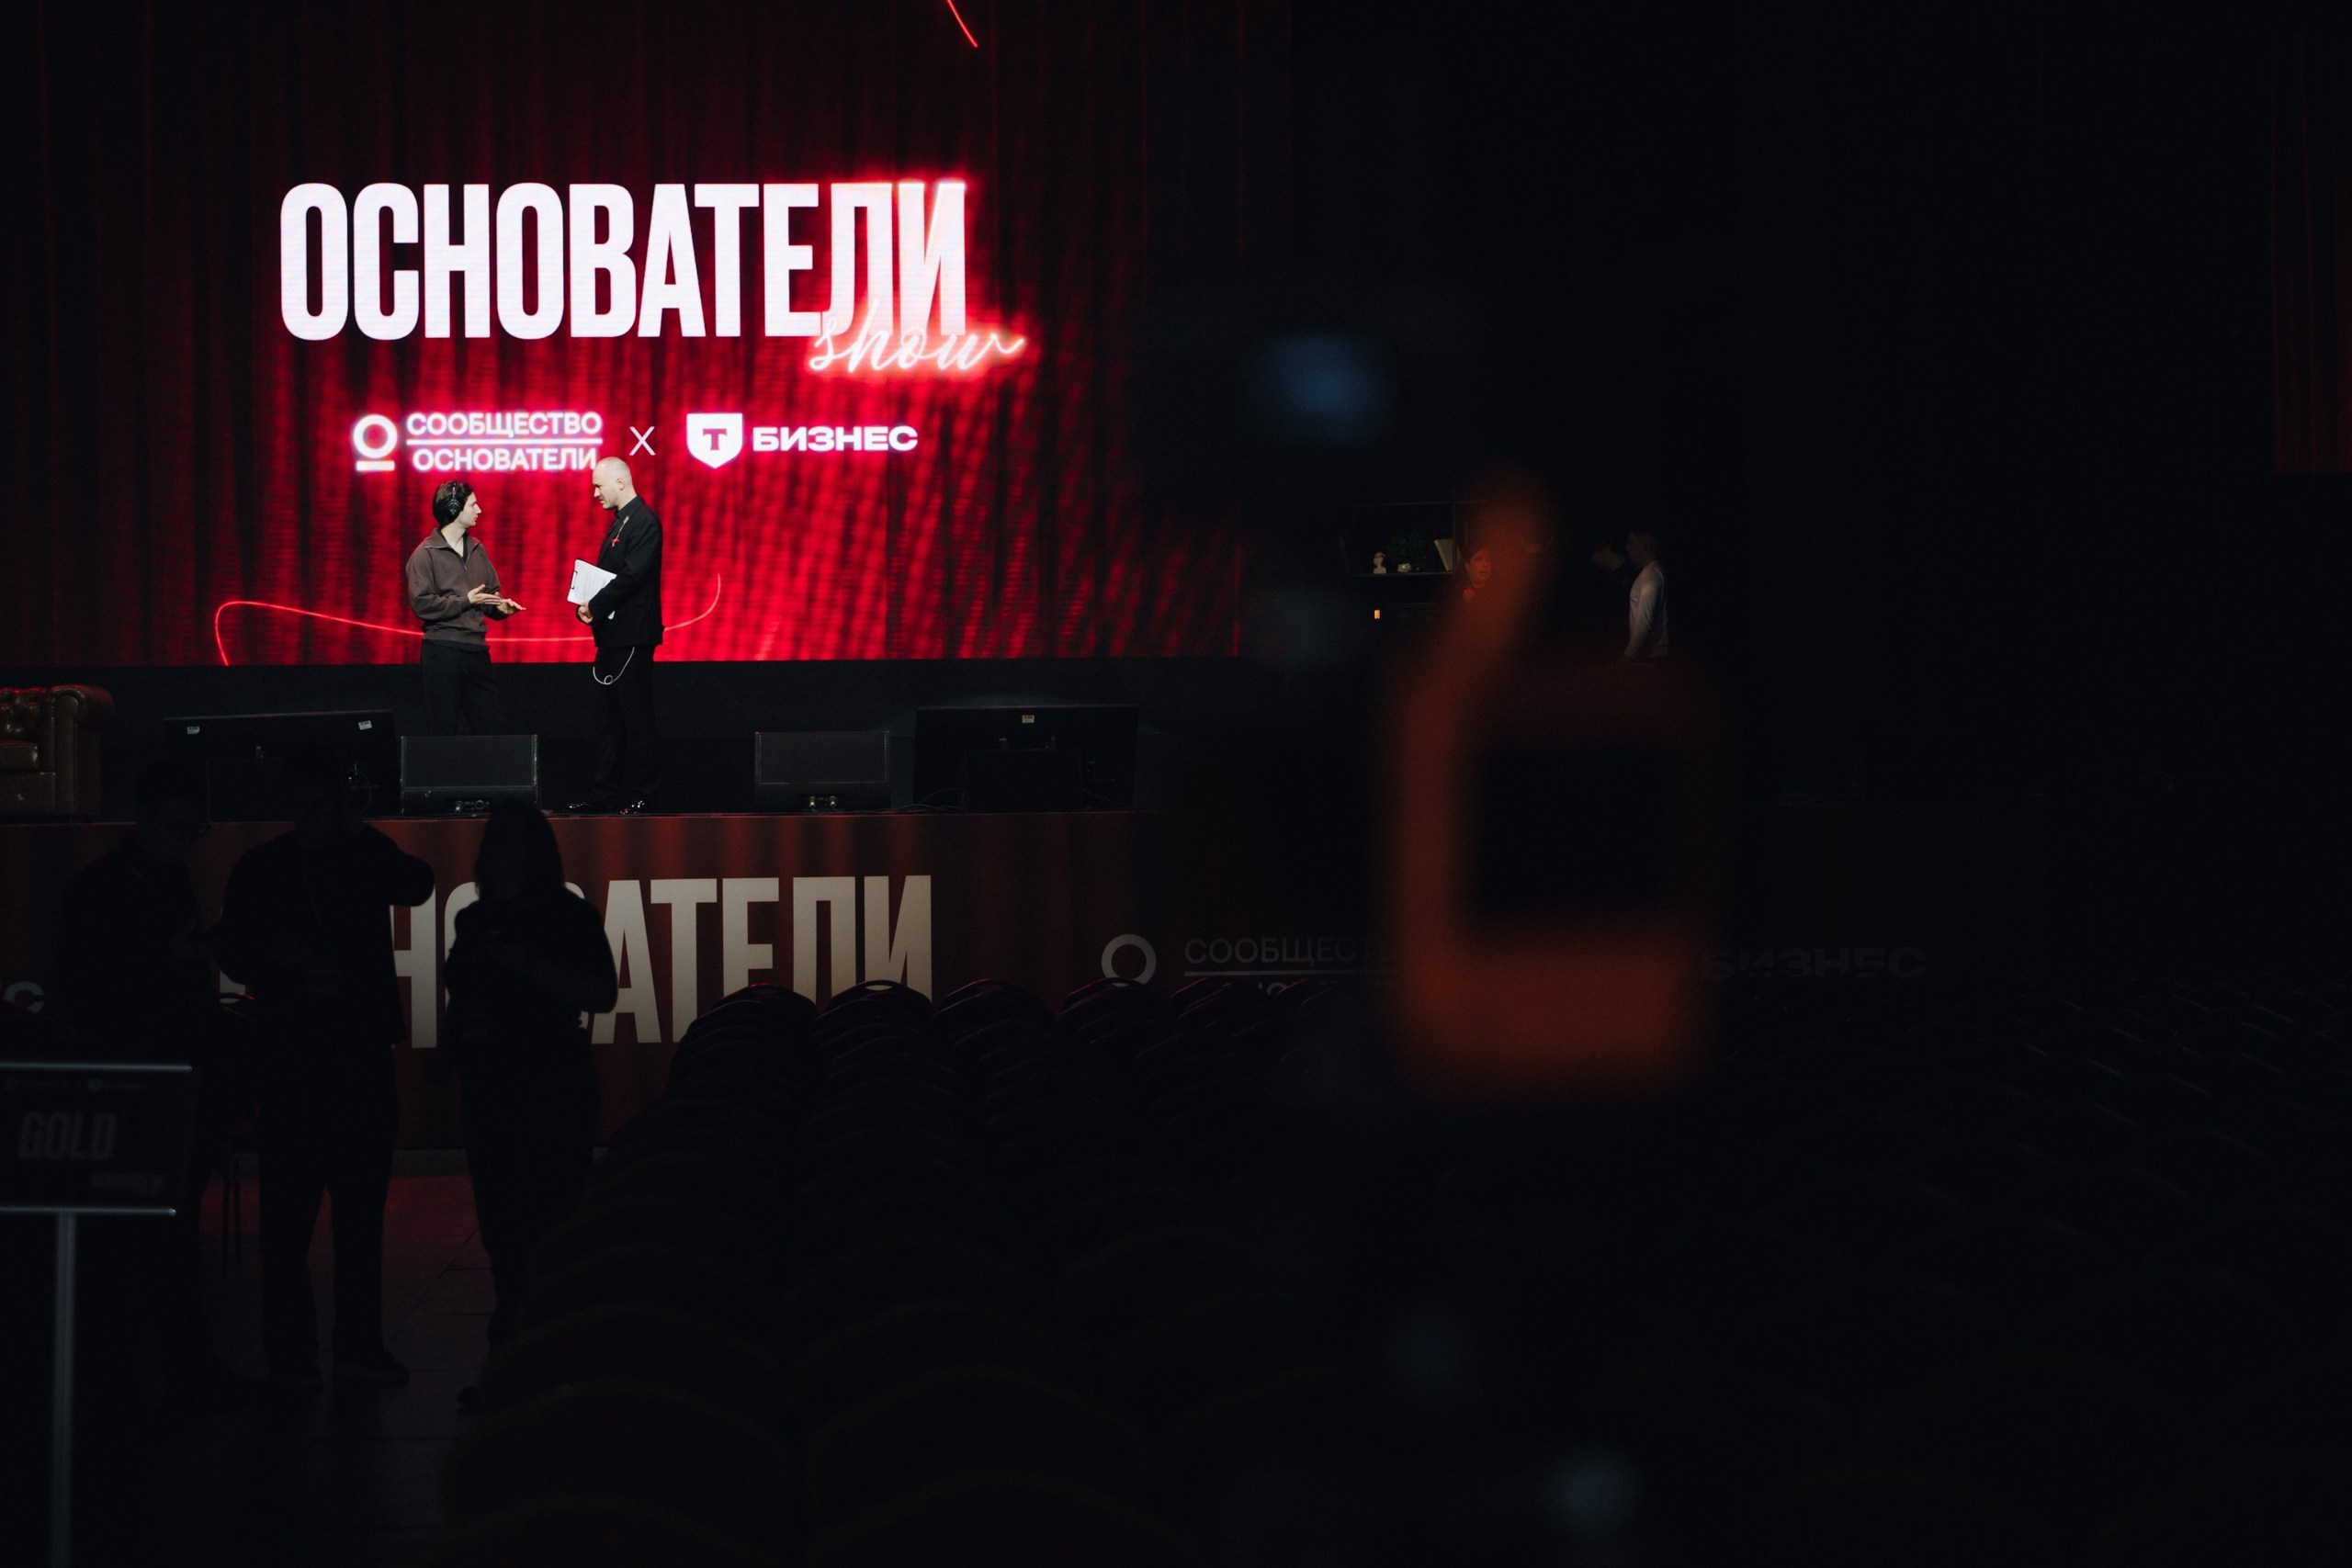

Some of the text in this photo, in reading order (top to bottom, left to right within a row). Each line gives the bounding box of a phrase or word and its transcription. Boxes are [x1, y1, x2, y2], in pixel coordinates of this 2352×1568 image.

[279, 181, 966, 341] ОСНОВАТЕЛИ
[808, 299, 1025, 373] show
[406, 412, 603, 437] СООБЩЕСТВО
[752, 425, 919, 452] БИЗНЕС
[412, 447, 597, 472] ОСНОВАТЕЛИ
[18, 1111, 118, 1162] GOLD
